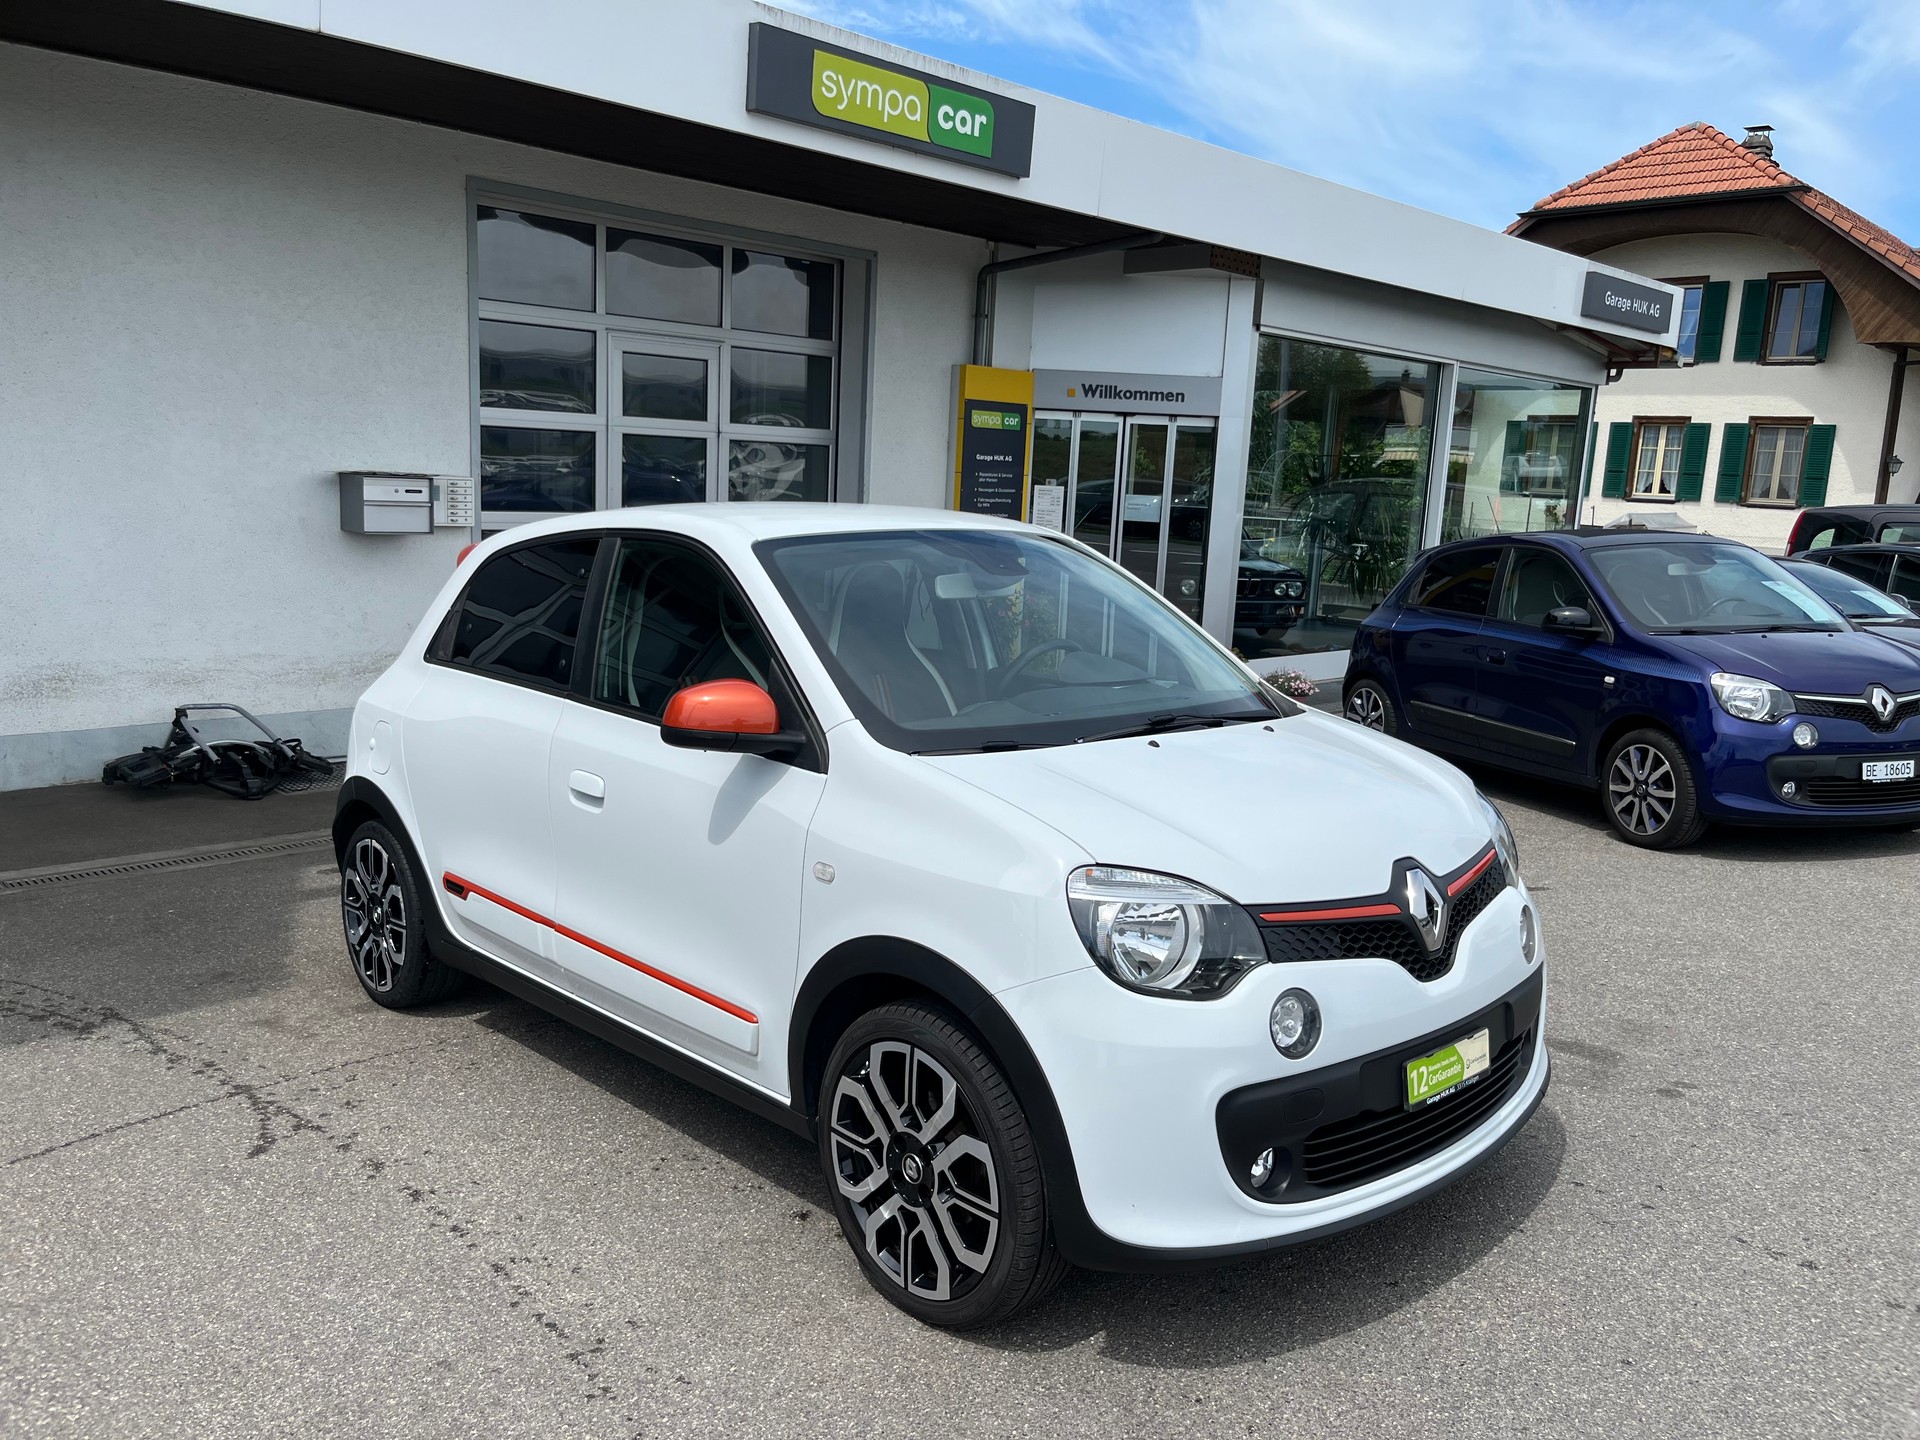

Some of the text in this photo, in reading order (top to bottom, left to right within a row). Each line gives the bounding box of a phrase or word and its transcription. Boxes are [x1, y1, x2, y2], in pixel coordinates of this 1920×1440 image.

[821, 70, 987, 137] sympa car
[1605, 291, 1660, 317] Garage HUK AG
[1081, 383, 1185, 403] Willkommen
[973, 415, 1019, 426] sympa car
[976, 454, 993, 462] Garage
[1866, 763, 1911, 777] BE 18605
[1410, 1066, 1428, 1097] 12
[1428, 1063, 1462, 1085] CarGarantie
[1426, 1094, 1441, 1104] Garage
[1440, 1089, 1450, 1098] HUK
[1450, 1086, 1456, 1094] AG
